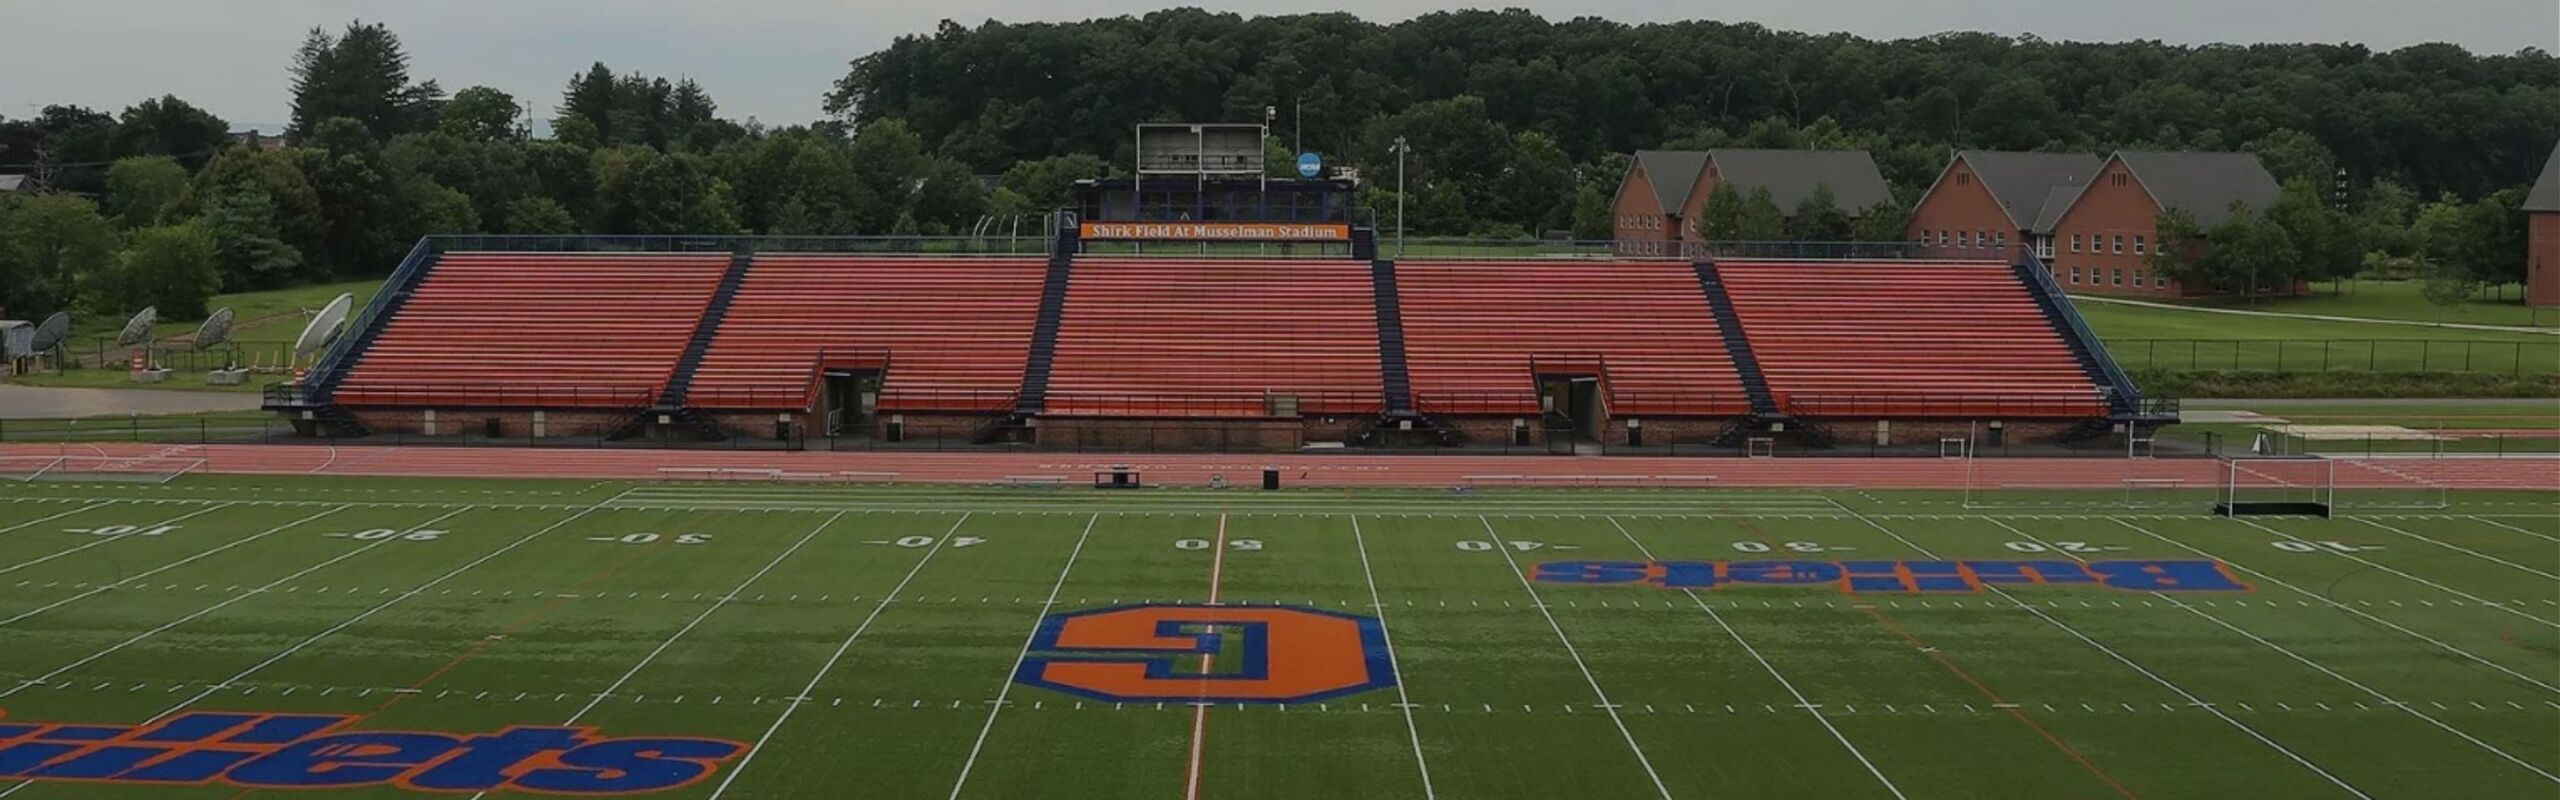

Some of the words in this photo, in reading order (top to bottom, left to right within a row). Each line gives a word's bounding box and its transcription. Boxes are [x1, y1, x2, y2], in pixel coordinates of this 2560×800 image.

[1092, 224, 1133, 238] Shirk
[1136, 224, 1170, 238] Field
[1174, 224, 1189, 238] At
[1194, 224, 1274, 238] Musselman
[1279, 224, 1337, 238] Stadium
[620, 532, 713, 544] 30
[895, 535, 987, 547] 40
[1175, 538, 1264, 550] 50
[1456, 540, 1545, 551] 40
[1731, 541, 1825, 552] 30
[1528, 556, 2258, 593] Bullets
[0, 706, 752, 796] llets
